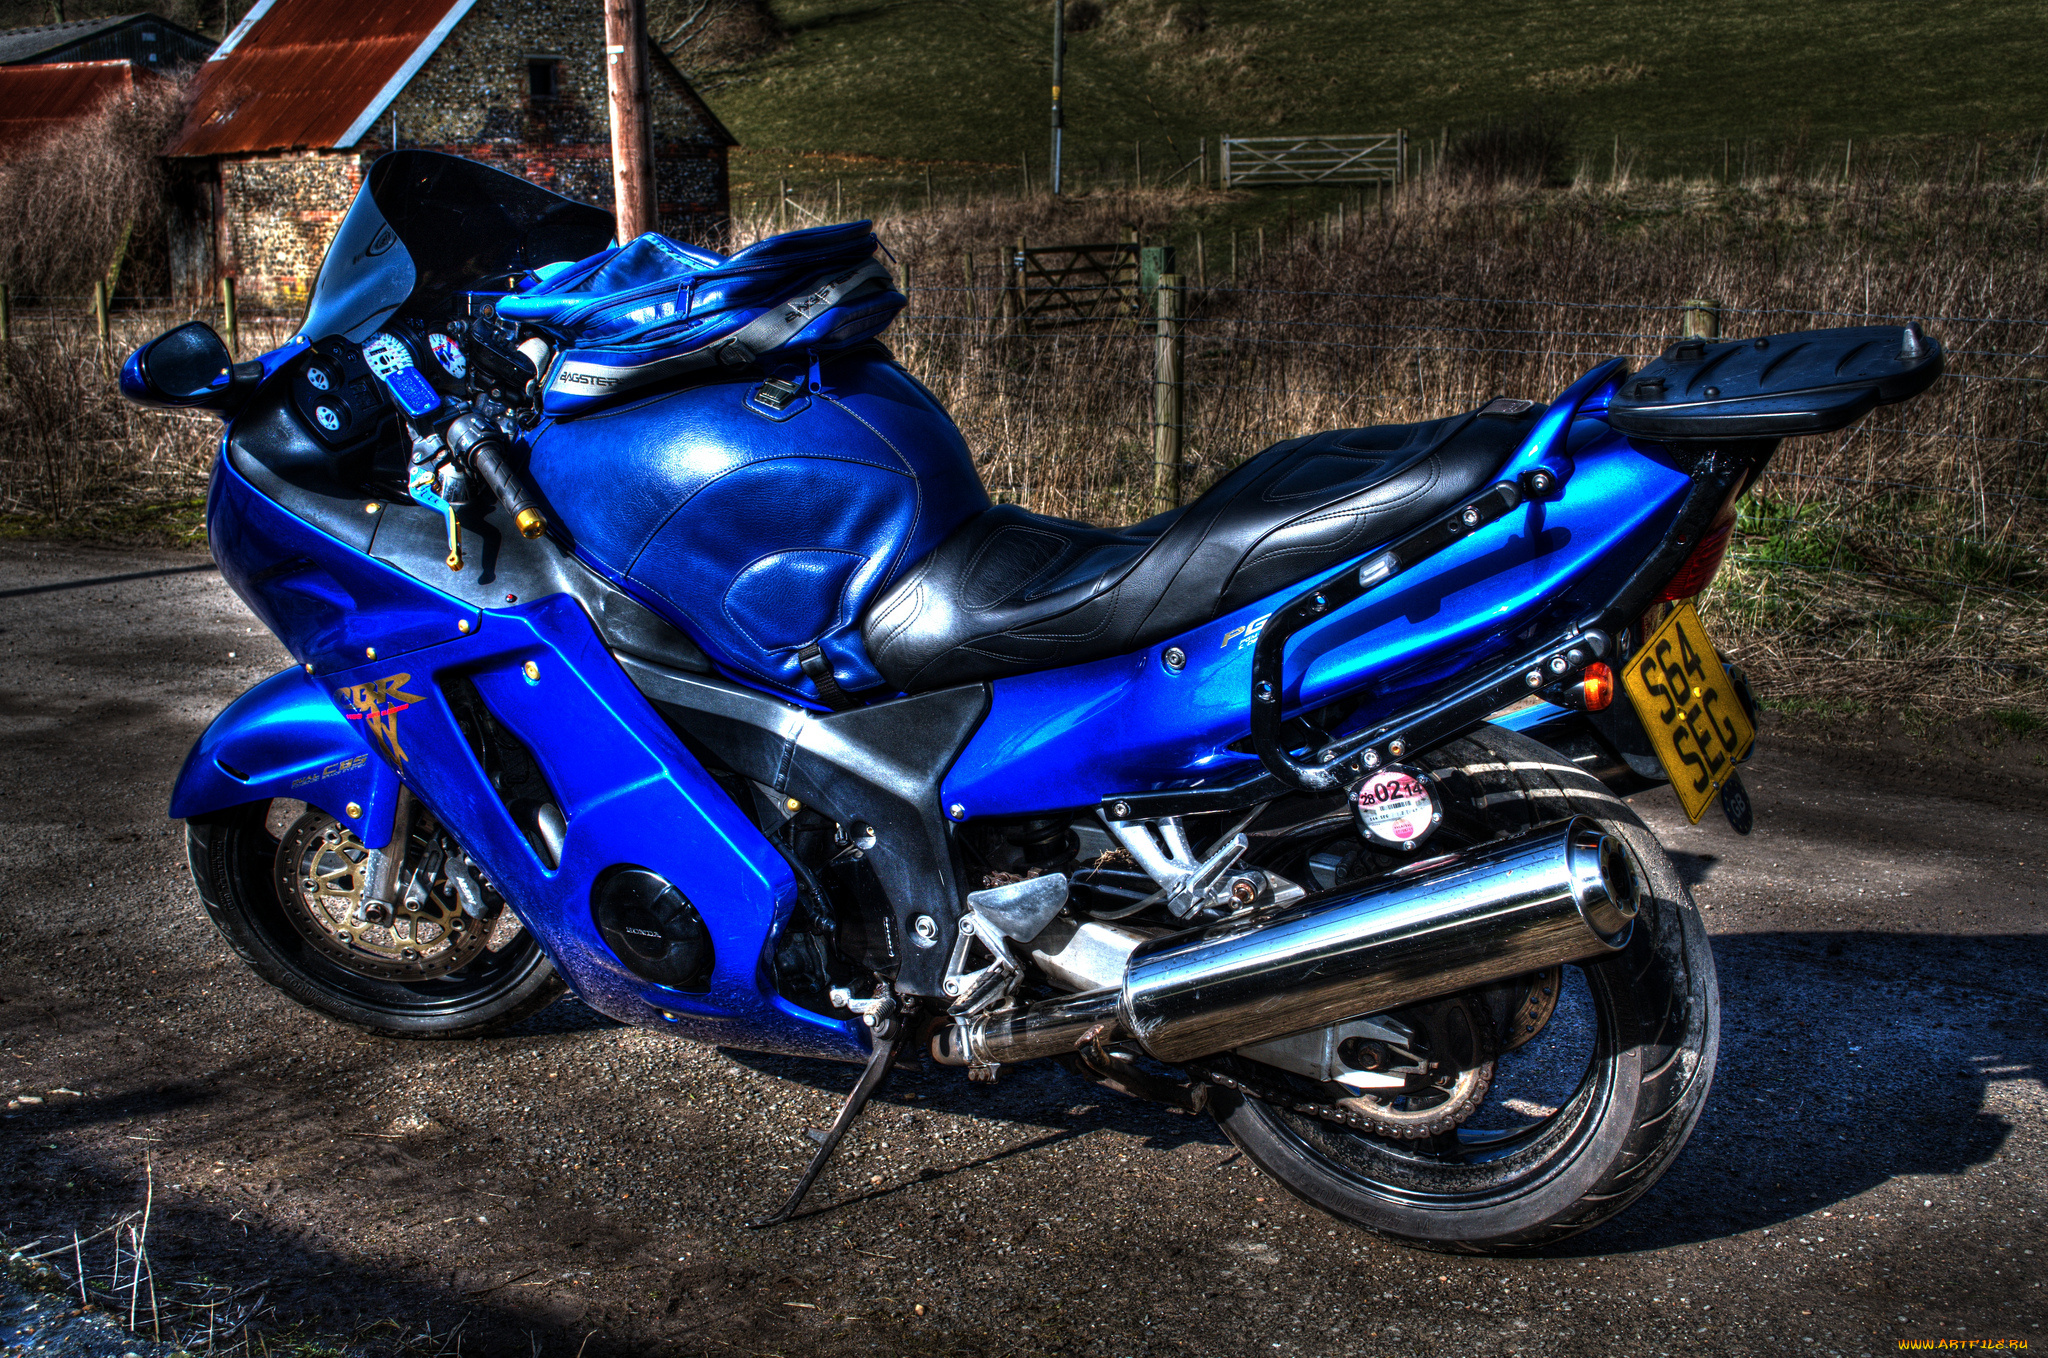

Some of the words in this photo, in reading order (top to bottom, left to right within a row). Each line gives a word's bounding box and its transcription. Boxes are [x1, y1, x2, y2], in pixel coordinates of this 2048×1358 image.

[560, 371, 622, 387] BAGSTER
[1640, 621, 1706, 725] S64
[333, 672, 427, 712] CBR
[1672, 687, 1738, 794] SEG
[322, 753, 369, 776] CBS
[1360, 793, 1376, 806] 28
[1374, 780, 1404, 802] 02
[1404, 781, 1423, 797] 14
[1730, 793, 1746, 818] GB
[625, 926, 662, 939] HONDA
